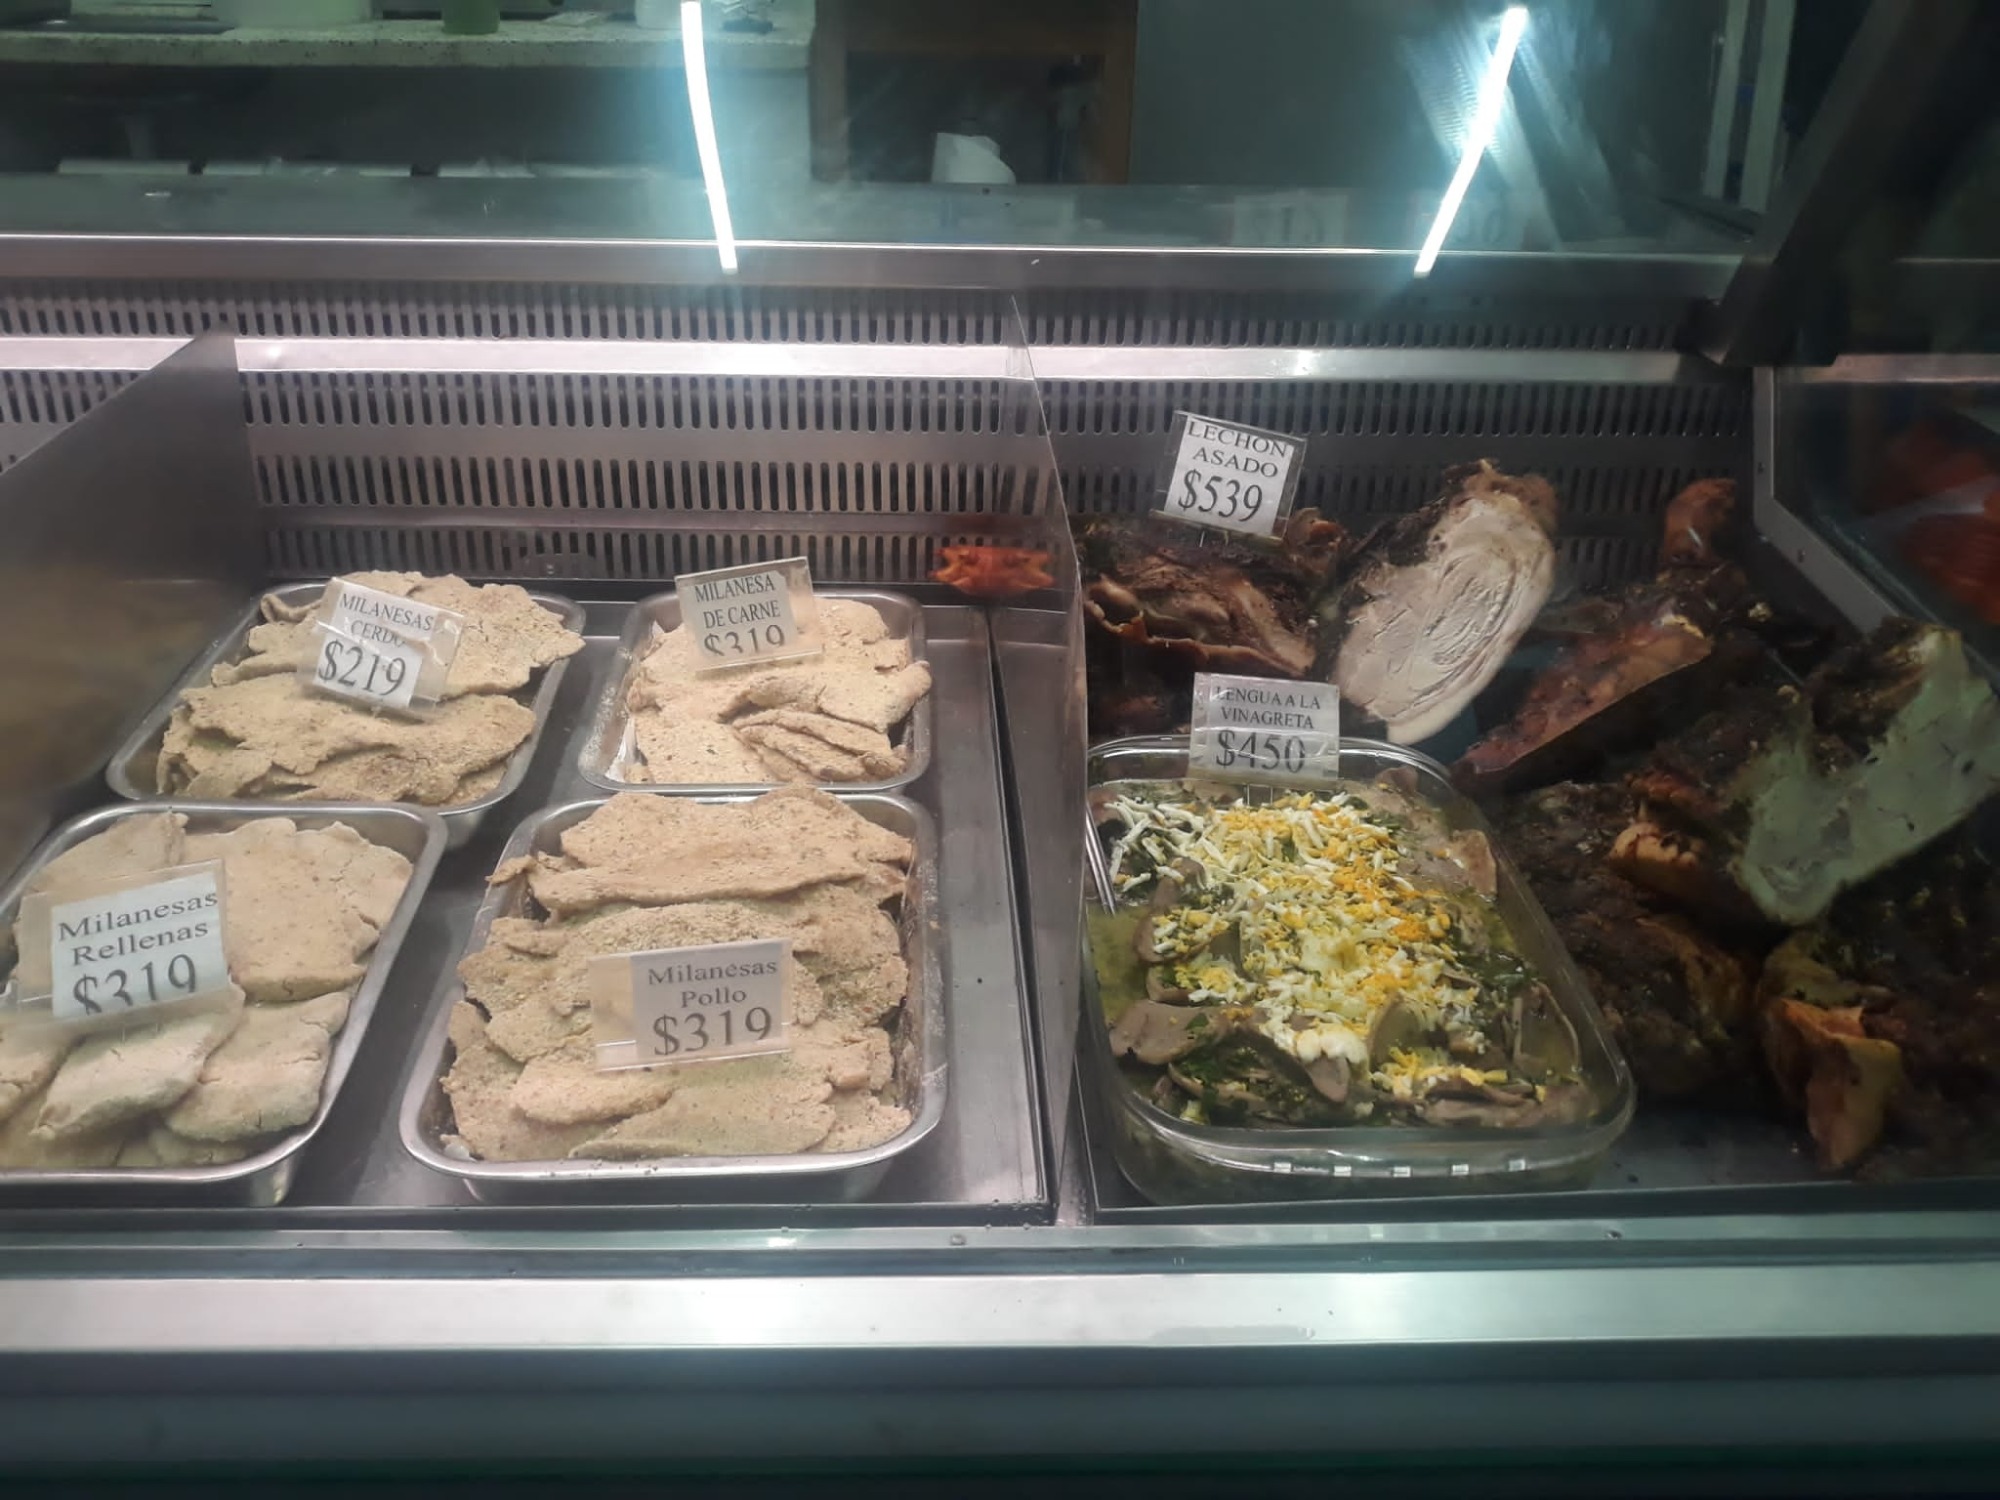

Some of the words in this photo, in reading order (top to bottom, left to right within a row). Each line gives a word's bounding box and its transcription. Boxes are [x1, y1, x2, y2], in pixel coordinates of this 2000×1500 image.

[1188, 421, 1289, 458] LECHON
[1193, 447, 1278, 478] ASADO
[1178, 469, 1263, 522] $539
[694, 573, 776, 602] MILANESA
[340, 593, 435, 631] MILANESAS
[703, 609, 726, 629] DE
[728, 600, 781, 625] CARNE
[351, 620, 407, 648] CERDO
[703, 624, 786, 657] $319
[318, 638, 407, 696] $219
[1216, 686, 1282, 707] LENGUA
[1284, 695, 1296, 707] A
[1300, 695, 1322, 710] LA
[1221, 706, 1315, 729] VINAGRETA
[1216, 730, 1306, 774] $450
[58, 892, 219, 942] Milanesas
[72, 922, 209, 966] Rellenas
[73, 954, 197, 1017] $319
[648, 961, 779, 986] Milanesas
[681, 987, 748, 1009] Pollo
[653, 1007, 772, 1056] $319
